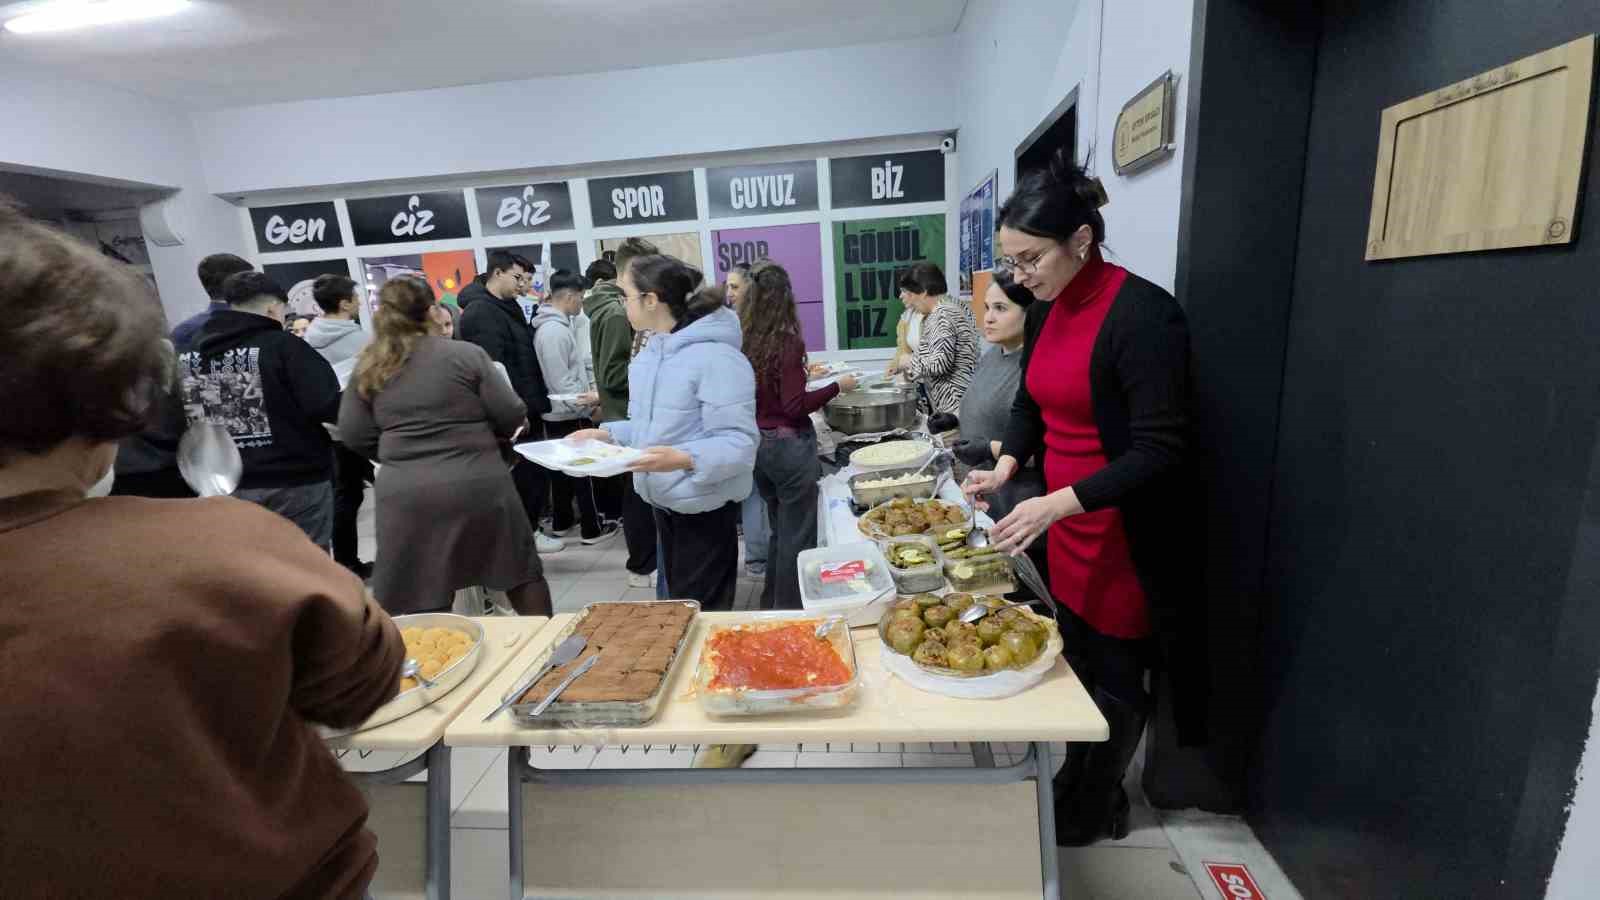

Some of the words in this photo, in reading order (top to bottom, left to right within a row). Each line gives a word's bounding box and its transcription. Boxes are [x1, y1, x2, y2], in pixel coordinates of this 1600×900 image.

[730, 174, 796, 210] CUYUZ
[871, 161, 904, 200] BİZ
[496, 186, 552, 228] Biz
[611, 186, 667, 220] SPOR
[264, 214, 326, 246] Gen
[845, 226, 927, 265] GÖNÜL
[847, 305, 889, 339] BİZ
[1219, 872, 1252, 900] SO
